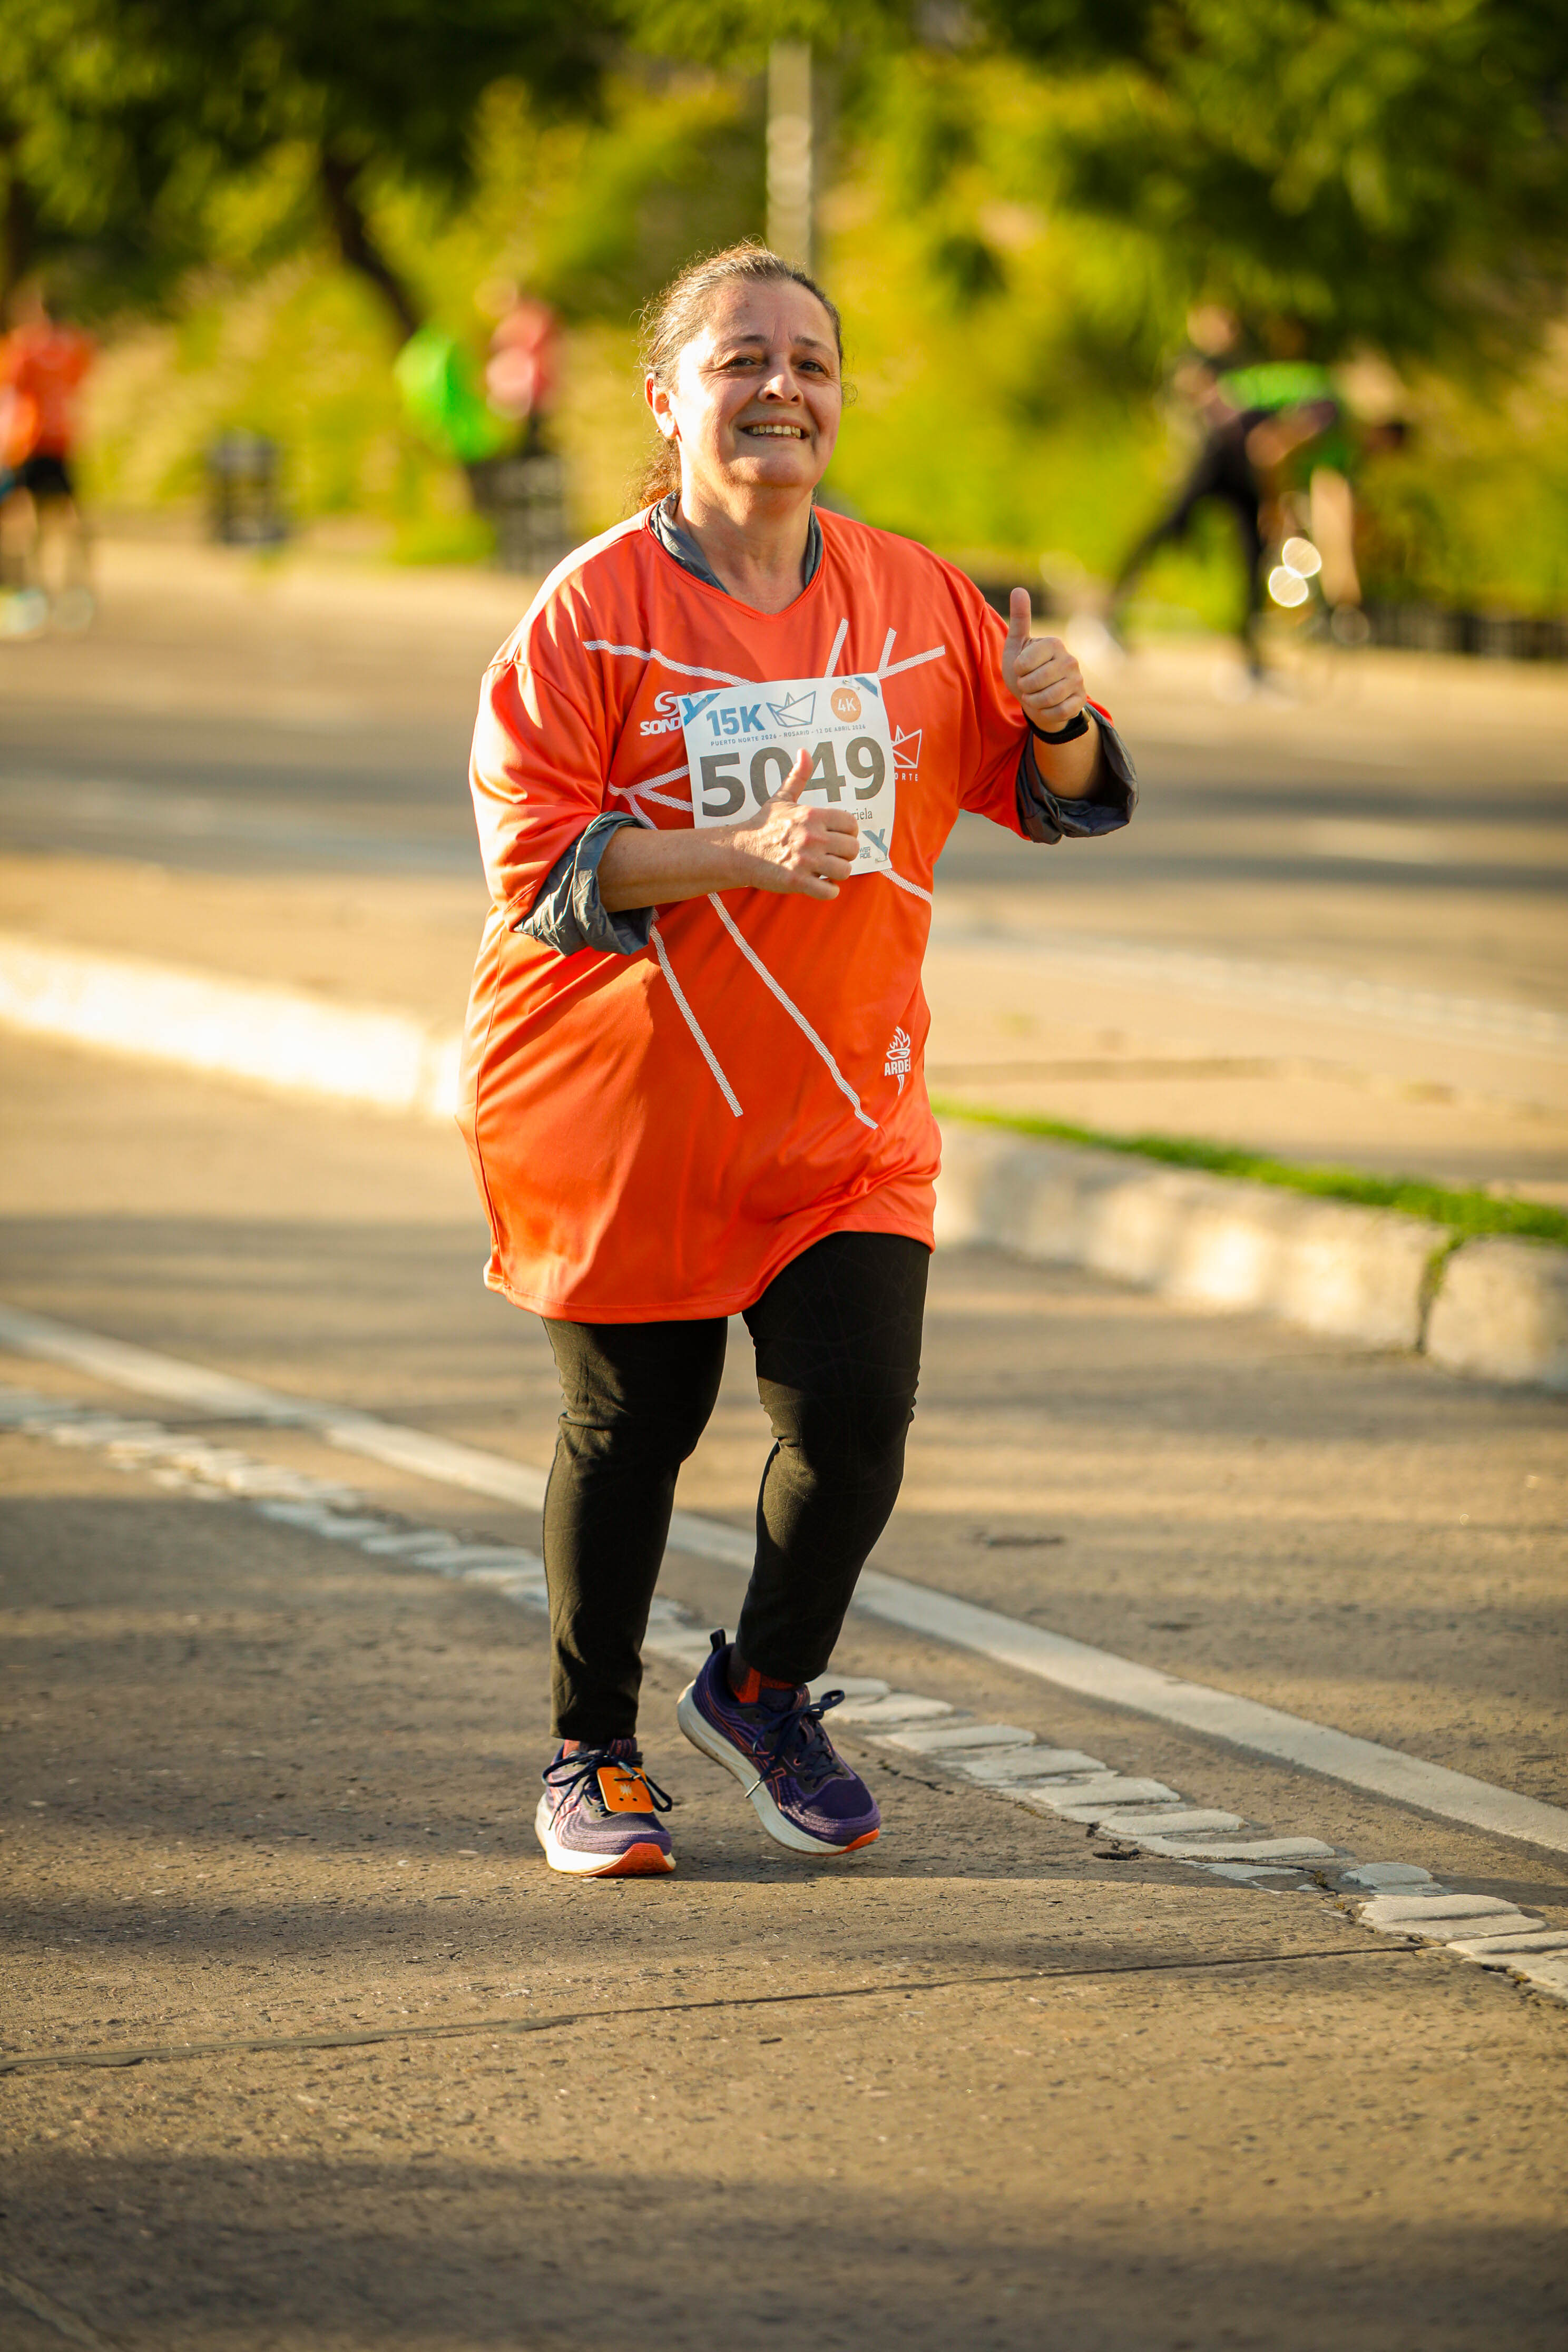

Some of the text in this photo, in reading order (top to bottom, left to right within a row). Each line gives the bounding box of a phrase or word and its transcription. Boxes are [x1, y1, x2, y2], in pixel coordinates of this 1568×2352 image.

[838, 698, 857, 712] 4K
[706, 703, 766, 736] 15K
[699, 736, 885, 817] 5049
[884, 1057, 911, 1076] ARDE
